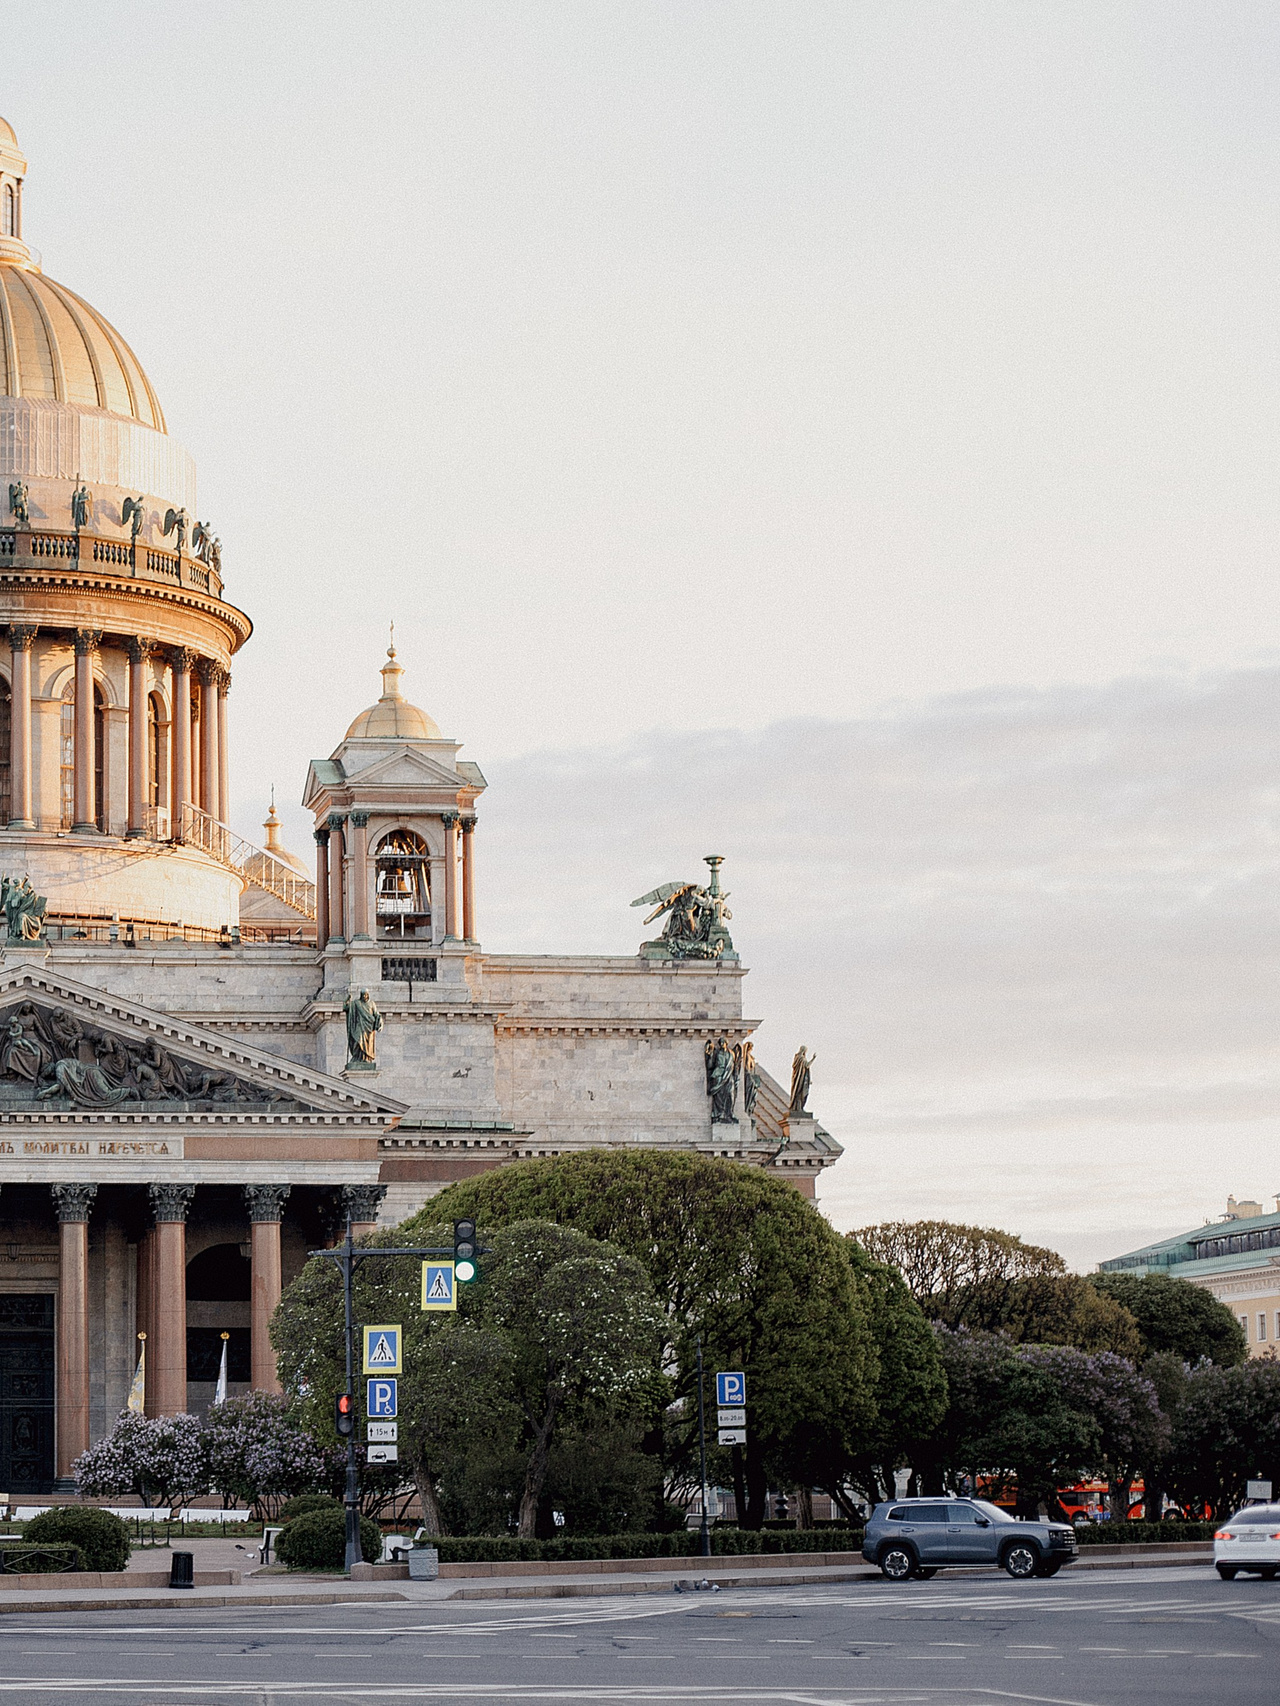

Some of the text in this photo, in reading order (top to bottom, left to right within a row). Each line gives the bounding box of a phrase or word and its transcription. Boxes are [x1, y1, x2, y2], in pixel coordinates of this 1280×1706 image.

[23, 1141, 90, 1154] МОЛИТВЫ
[375, 1383, 392, 1413] P
[724, 1376, 740, 1402] P
